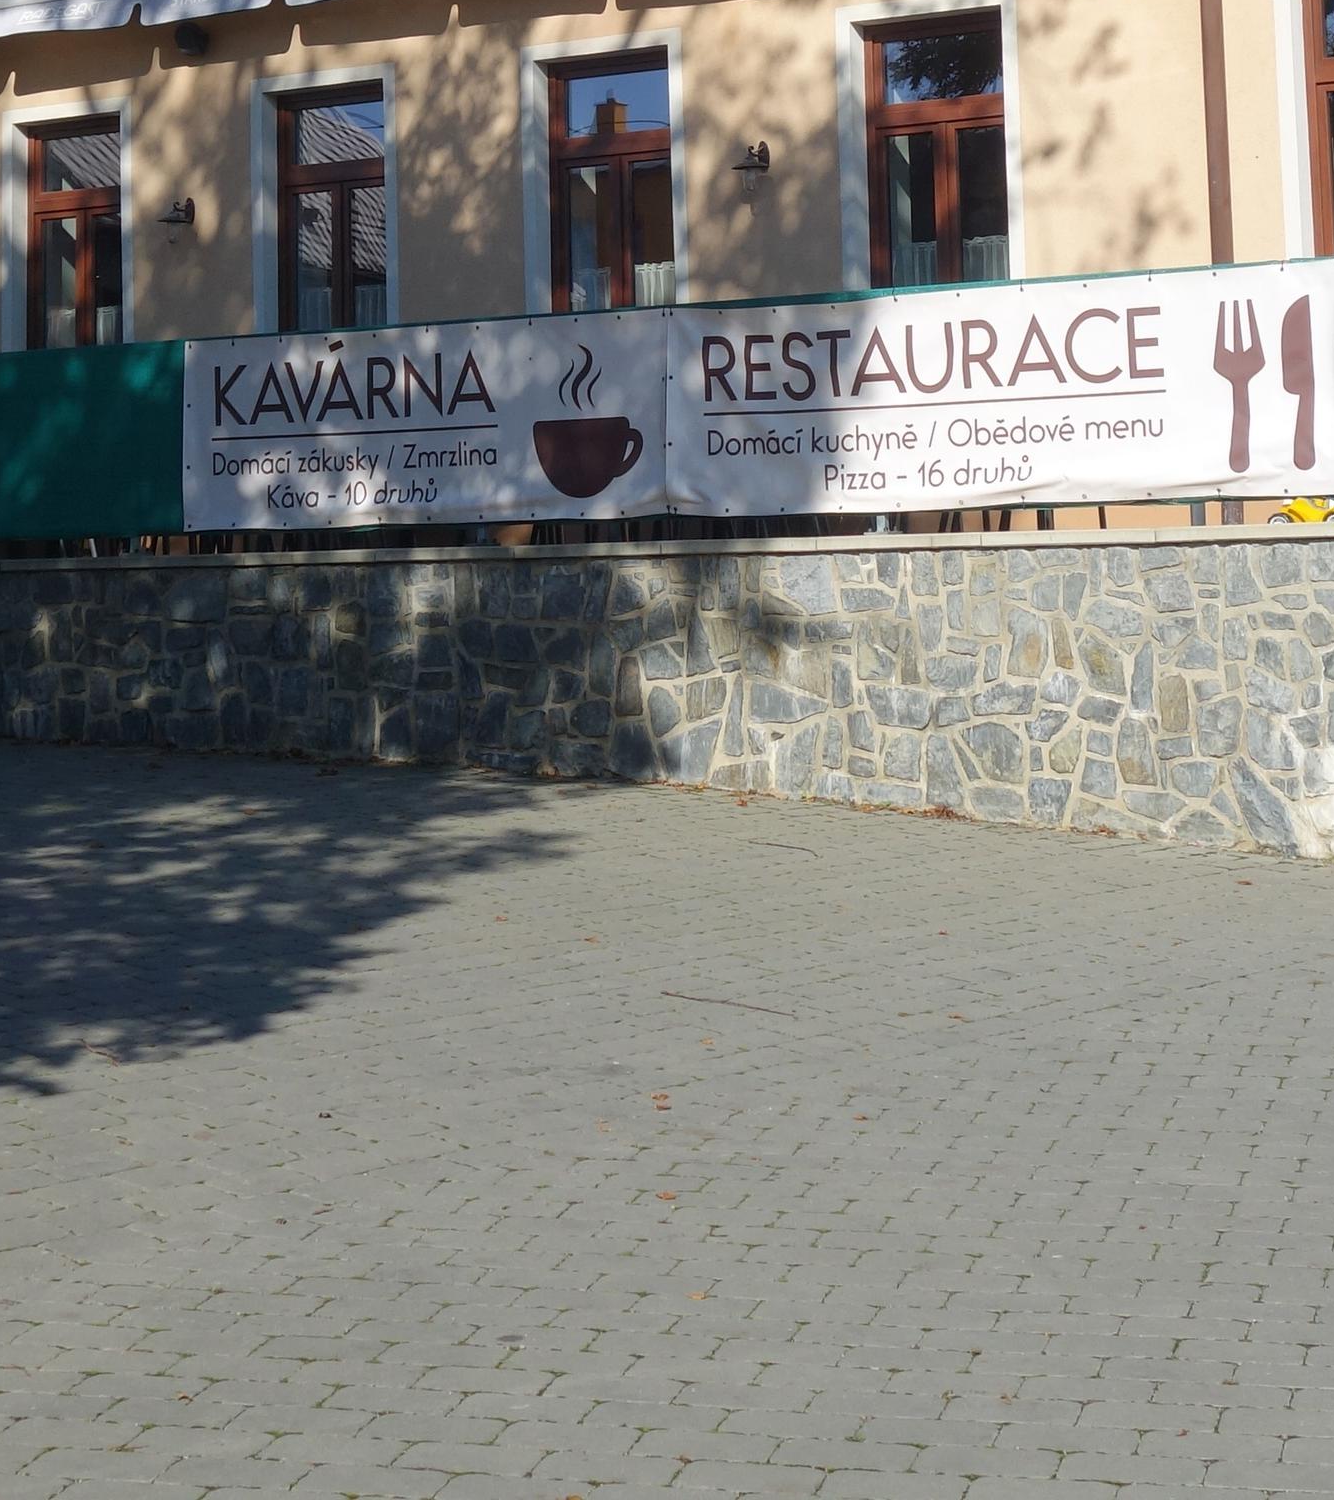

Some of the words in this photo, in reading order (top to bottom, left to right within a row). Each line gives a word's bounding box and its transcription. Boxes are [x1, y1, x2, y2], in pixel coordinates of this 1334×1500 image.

[702, 305, 1165, 403] RESTAURACE
[214, 340, 496, 426] KAVÁRNA
[707, 428, 804, 457] Domácí
[811, 423, 918, 461] kuchyně
[928, 420, 937, 448] /
[948, 415, 1075, 447] Obědové
[1085, 418, 1164, 441] menu
[212, 450, 291, 477] Domácí
[298, 446, 379, 480] zákusky
[387, 444, 395, 471] /
[403, 441, 498, 470] Zmrzlina
[824, 463, 886, 491] Pizza
[917, 459, 945, 488] 16
[953, 454, 1033, 487] druhů
[267, 484, 319, 509] Káva
[345, 480, 368, 506] 10
[373, 477, 438, 505] druhů
